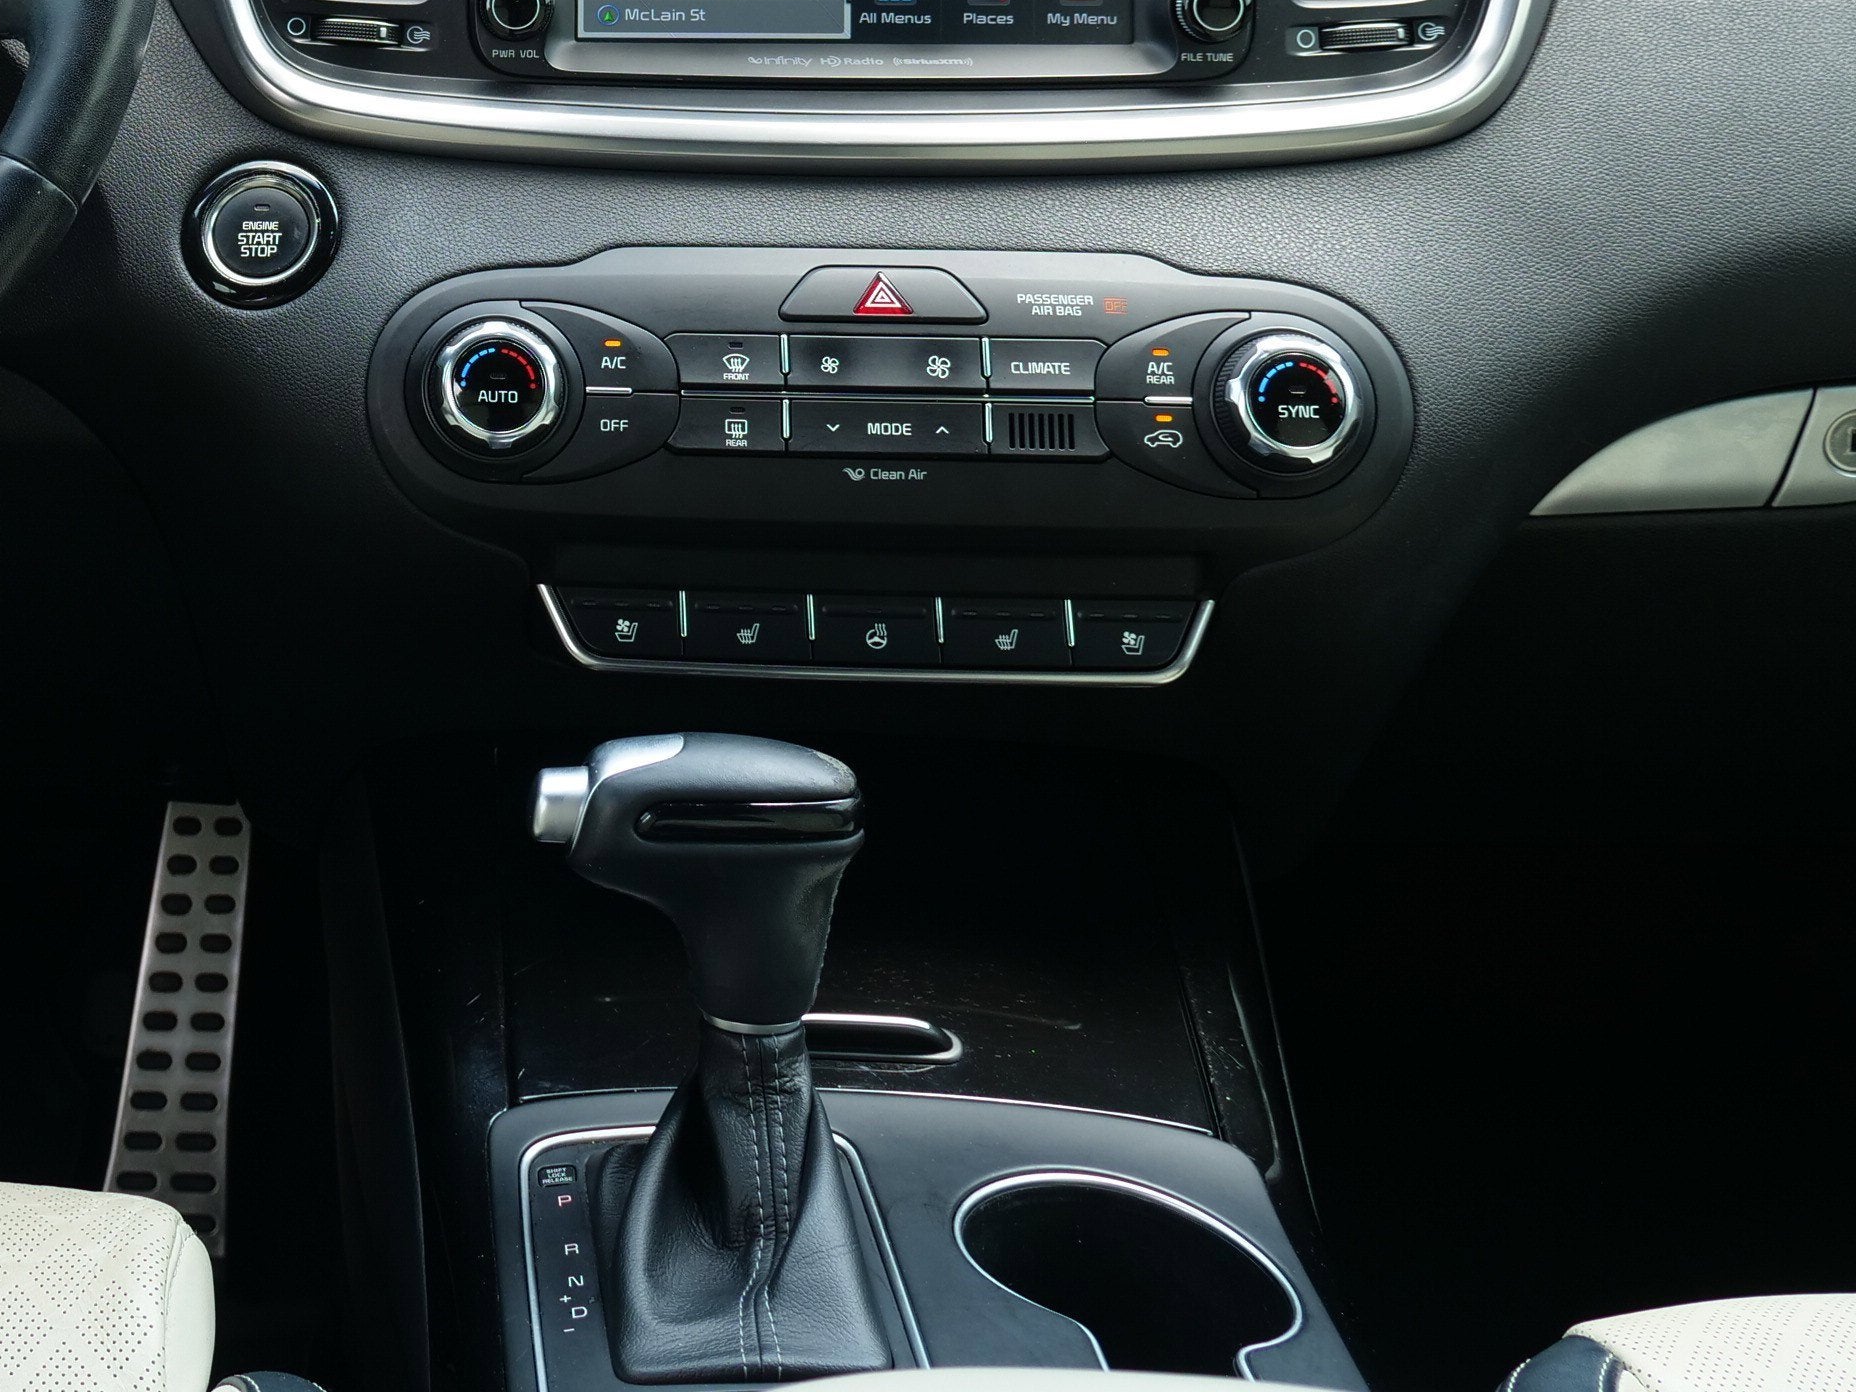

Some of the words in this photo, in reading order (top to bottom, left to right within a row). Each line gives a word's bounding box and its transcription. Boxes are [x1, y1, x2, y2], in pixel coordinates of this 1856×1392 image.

[625, 8, 685, 21] McLain
[690, 8, 706, 21] St
[859, 12, 879, 24] All
[881, 12, 932, 25] Menus
[963, 12, 1014, 25] Places
[1047, 13, 1071, 27] My
[1074, 13, 1117, 26] Menu
[491, 49, 516, 59] PWR
[519, 49, 540, 59] VOL
[1180, 53, 1203, 63] FILE
[1206, 53, 1234, 63] TUNE
[844, 56, 884, 66] Radio
[242, 221, 279, 231] ENGINE
[237, 232, 283, 245] START
[240, 245, 278, 258] STOP
[1016, 293, 1094, 306] PASSENGER
[1031, 305, 1054, 316] AIR
[1055, 306, 1082, 316] BAG
[600, 356, 627, 371] A/C
[1010, 361, 1071, 375] CLIMATE
[1147, 361, 1174, 376] A/C
[723, 372, 750, 381] FRONT
[1146, 375, 1175, 385] REAR
[477, 389, 519, 404] AUTO
[1278, 405, 1320, 419] SYNC
[600, 418, 629, 432] OFF
[867, 422, 912, 436] MODE
[725, 438, 748, 447] REAR
[870, 467, 905, 481] Clean
[907, 467, 927, 481] Air
[557, 1195, 572, 1207] P
[564, 1243, 579, 1256] R
[568, 1275, 584, 1288] N
[571, 1306, 588, 1319] D
